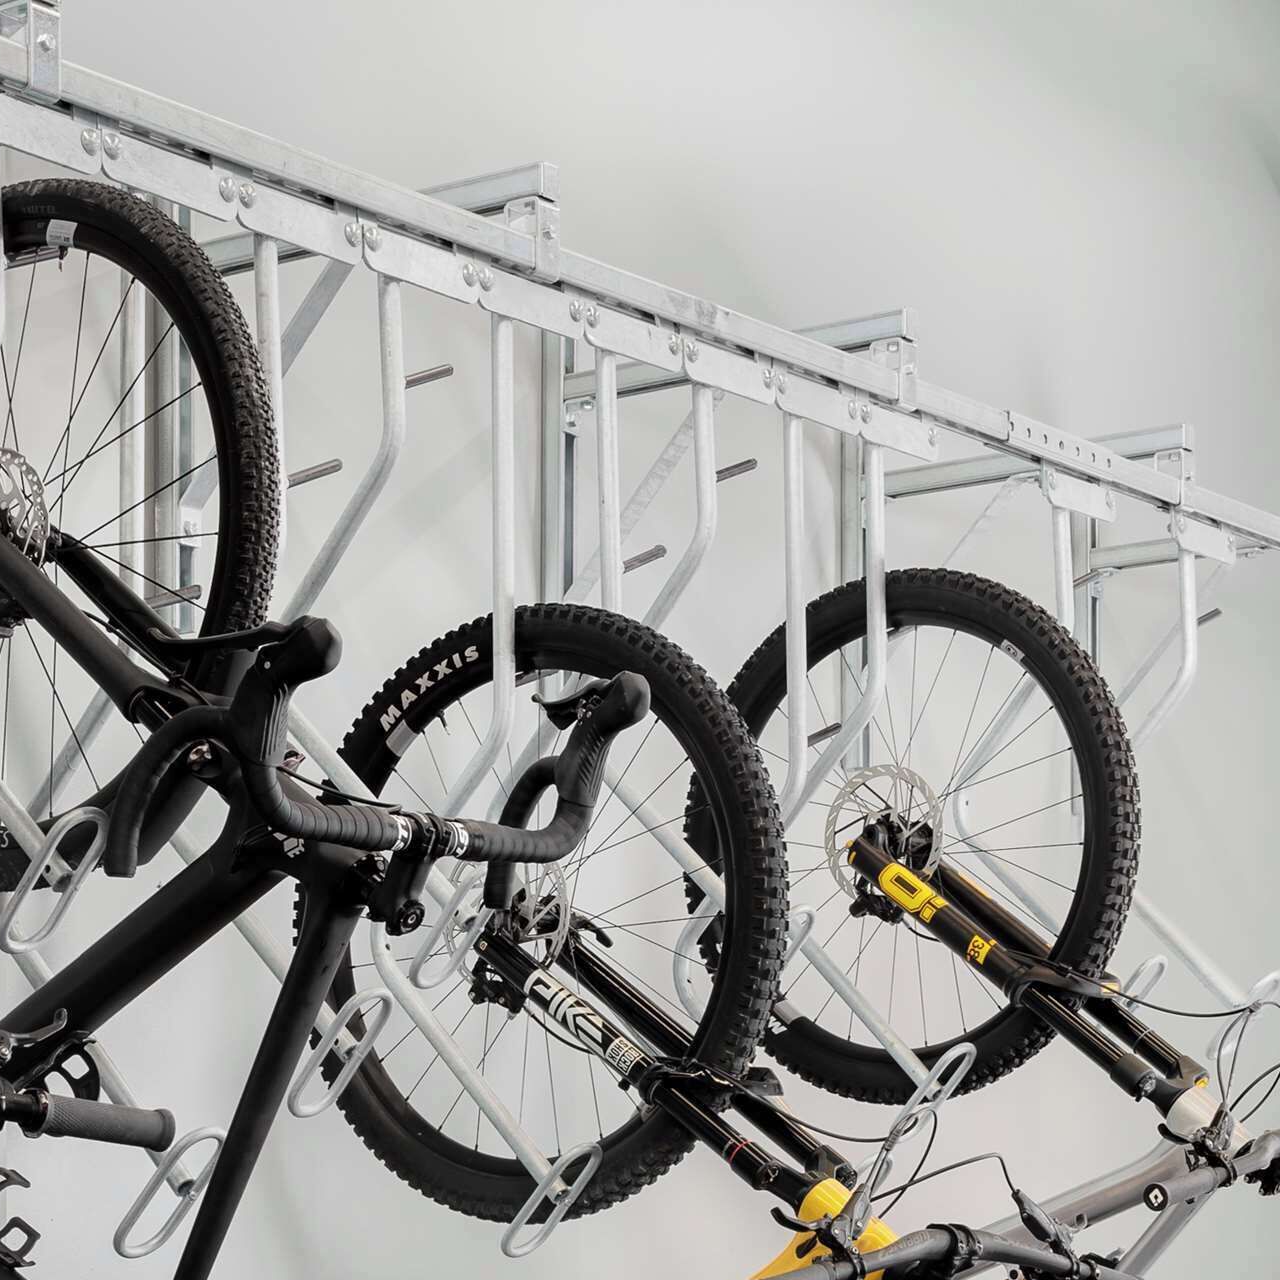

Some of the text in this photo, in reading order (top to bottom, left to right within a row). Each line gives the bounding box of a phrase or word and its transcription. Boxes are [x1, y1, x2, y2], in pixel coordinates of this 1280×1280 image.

[379, 645, 480, 732] MAXXIS
[968, 939, 985, 960] 38
[523, 968, 605, 1057] PIKE
[608, 1039, 629, 1062] SHOX
